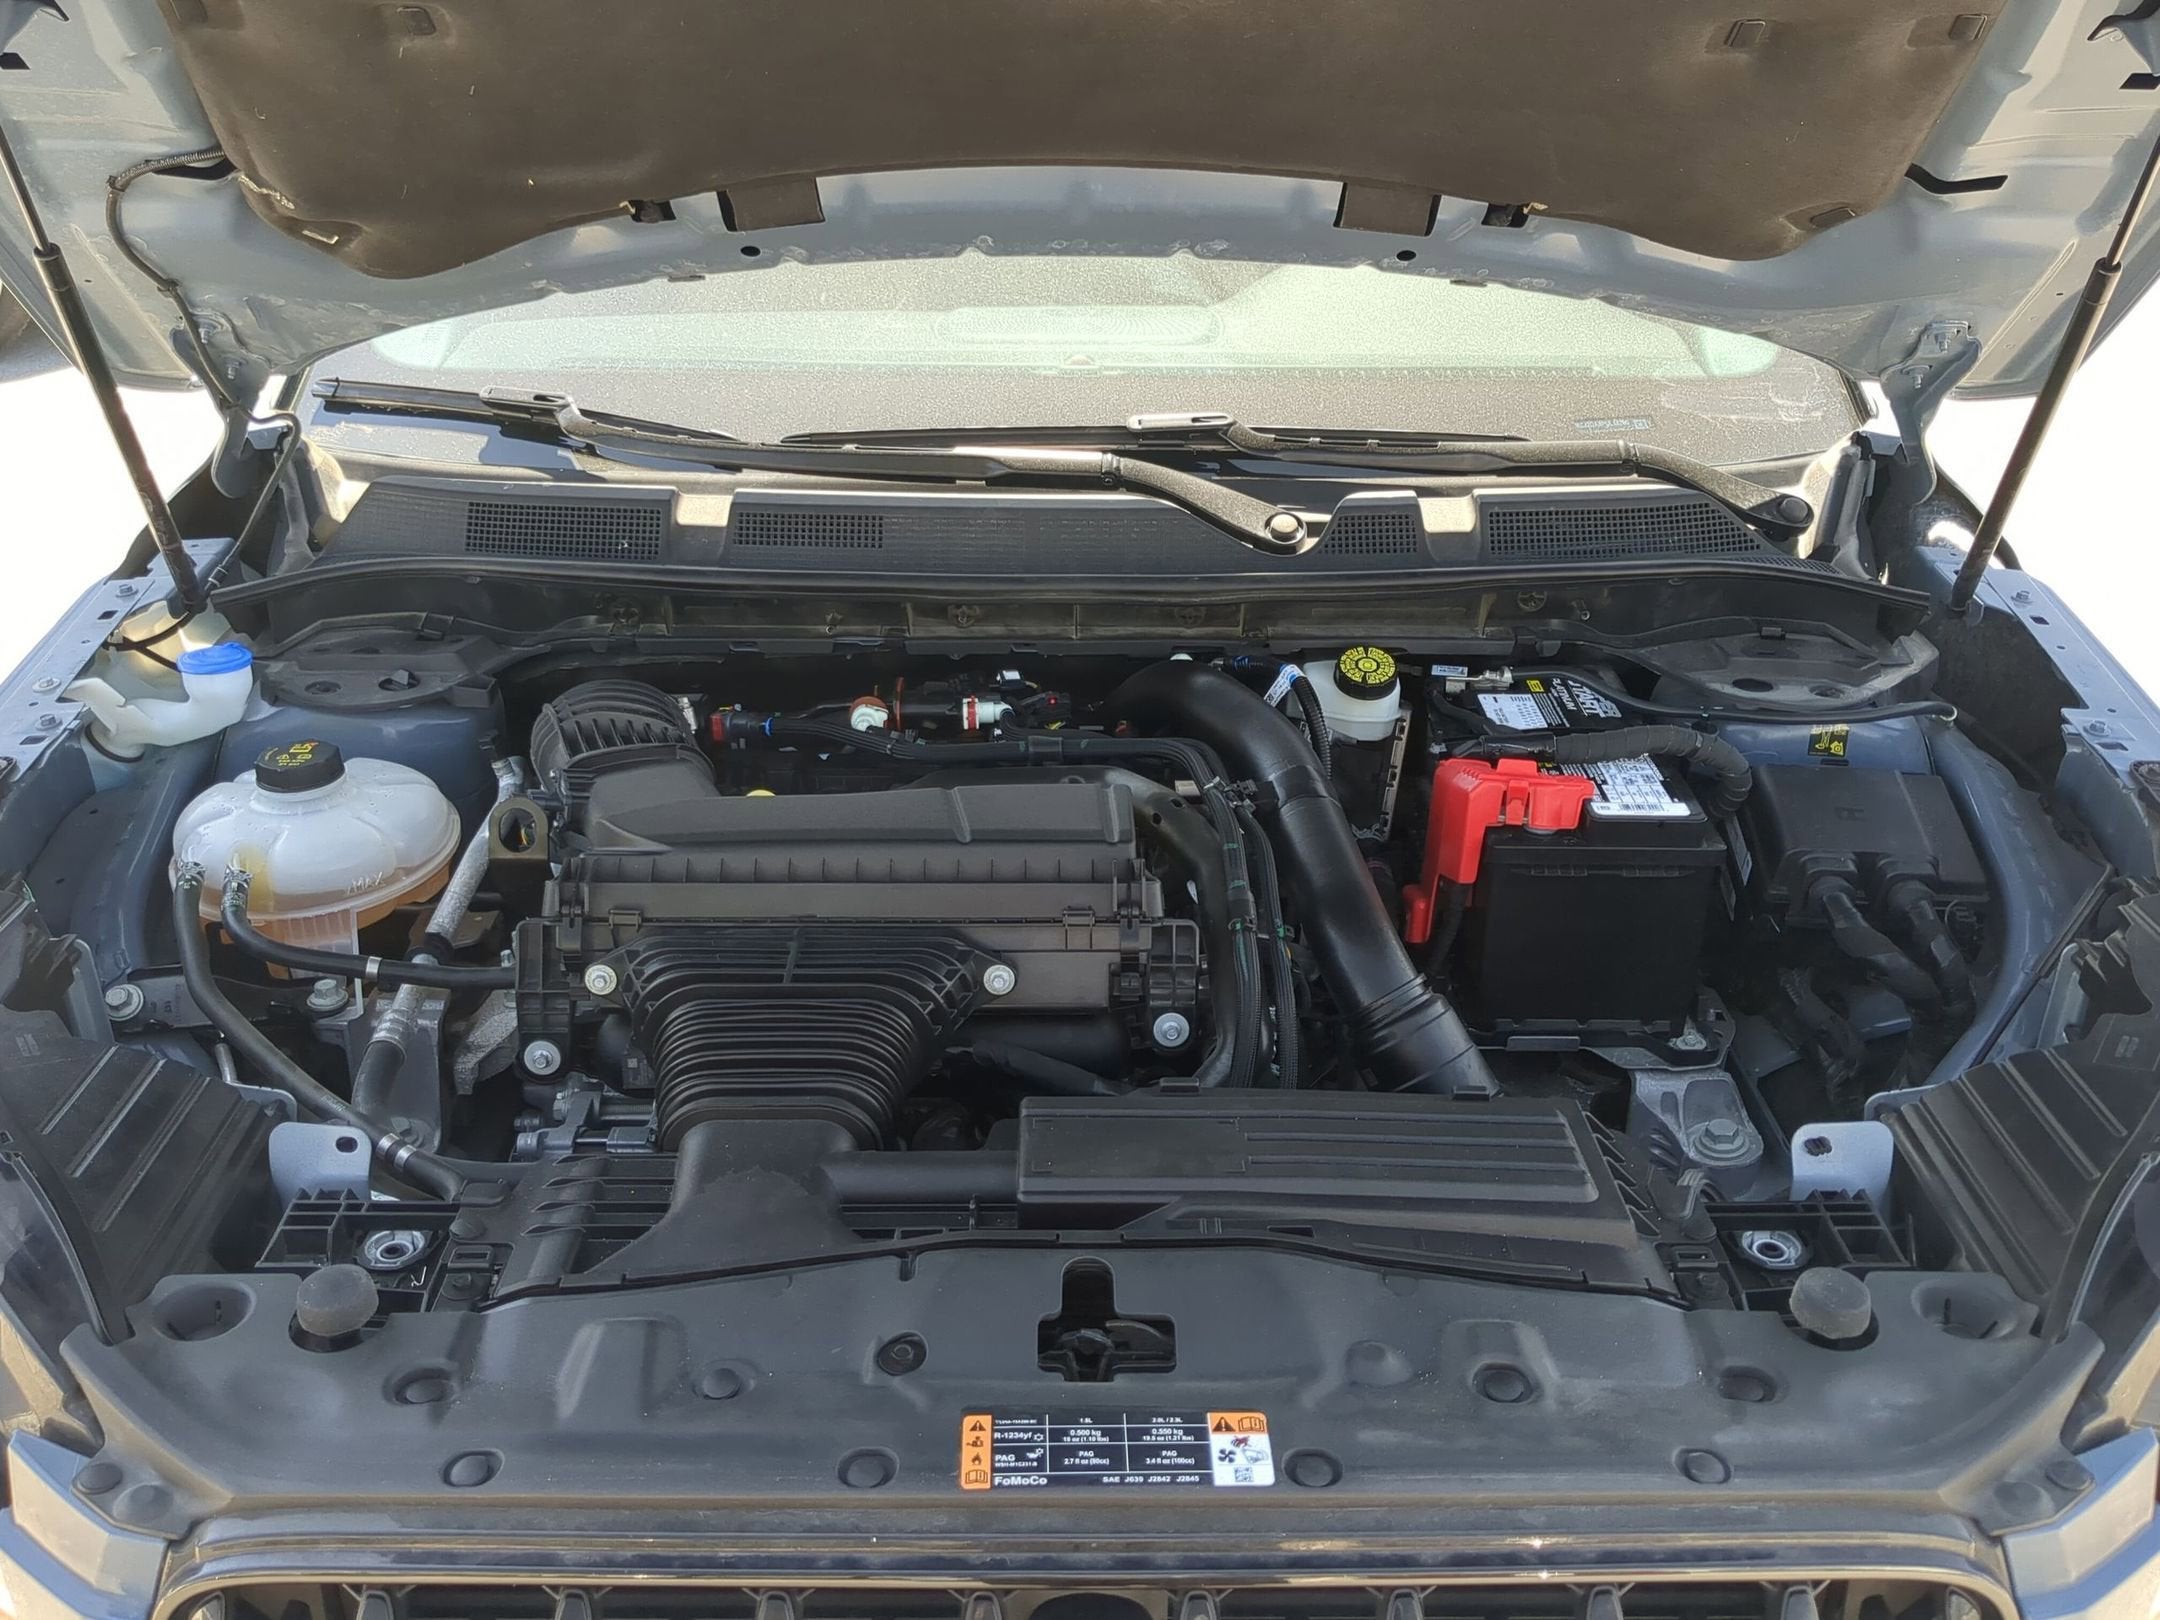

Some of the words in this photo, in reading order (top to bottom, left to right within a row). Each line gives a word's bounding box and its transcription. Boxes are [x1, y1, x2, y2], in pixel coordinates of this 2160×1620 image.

[994, 1431, 1033, 1440] R-1234yf
[1091, 1429, 1101, 1437] kg
[1173, 1428, 1184, 1436] kg
[995, 1454, 1016, 1462] PAG
[994, 1475, 1048, 1486] FoMoCo
